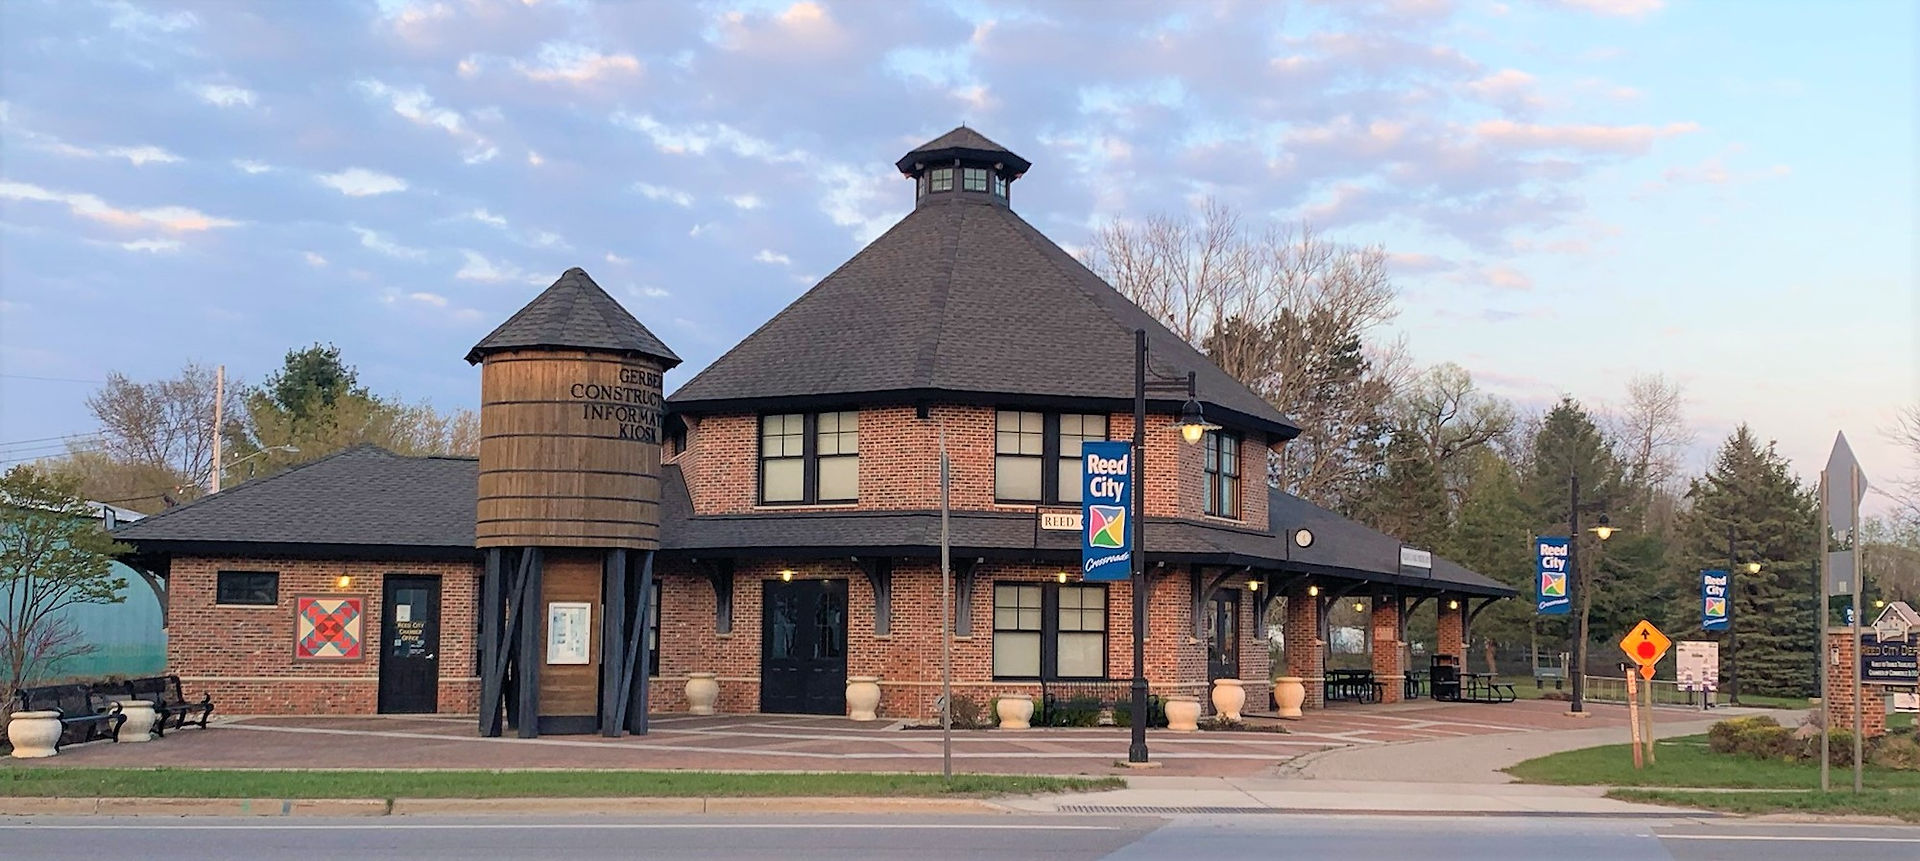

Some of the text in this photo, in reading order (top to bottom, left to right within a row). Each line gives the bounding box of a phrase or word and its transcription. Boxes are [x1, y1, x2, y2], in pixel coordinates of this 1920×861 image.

[619, 423, 657, 442] KIOSK
[1087, 454, 1128, 475] Reed
[1090, 476, 1124, 503] City
[1045, 516, 1074, 527] REED
[1540, 543, 1568, 556] Reed
[1542, 556, 1566, 571] City
[1704, 575, 1727, 585] Reed
